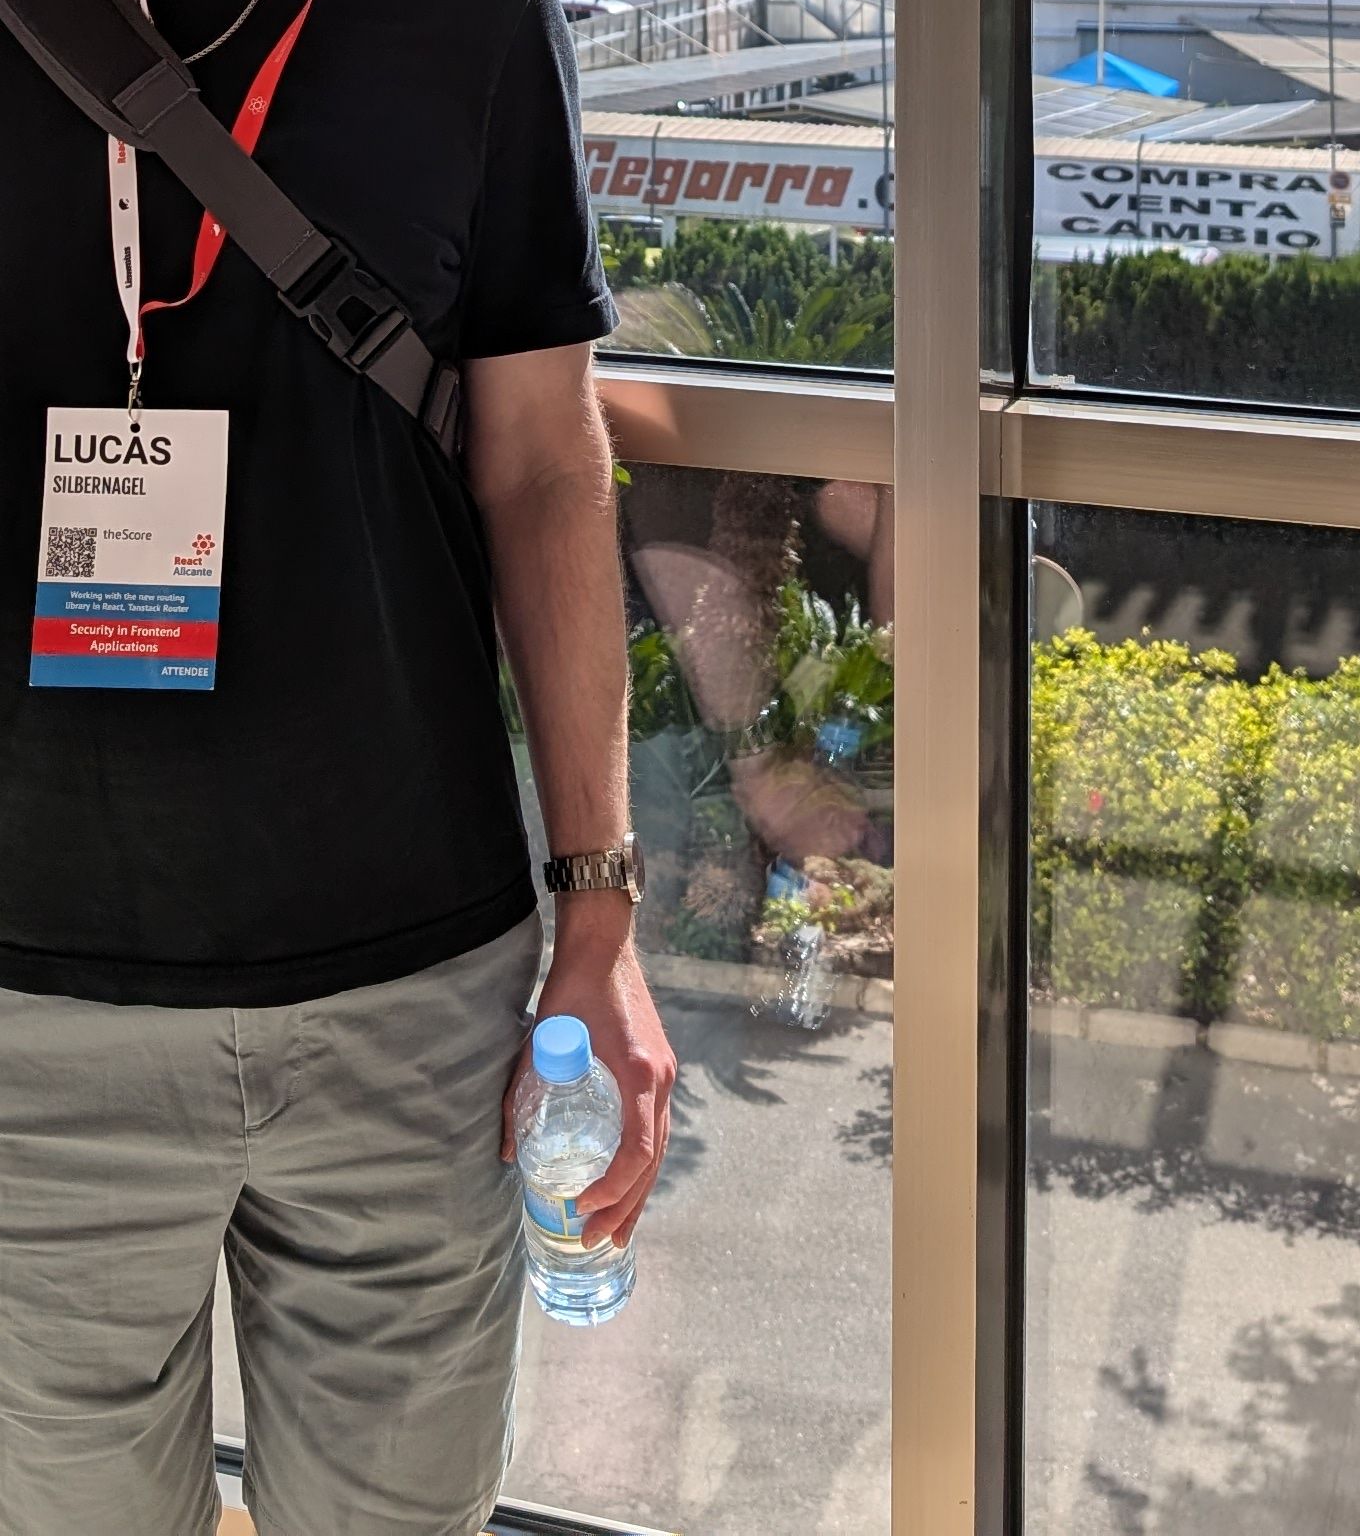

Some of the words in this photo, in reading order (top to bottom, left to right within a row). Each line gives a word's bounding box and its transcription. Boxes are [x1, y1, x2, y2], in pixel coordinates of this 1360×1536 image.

[1046, 163, 1326, 193] COMPRA
[1080, 191, 1300, 220] VENTA
[1061, 216, 1321, 249] CAMBIO
[54, 434, 172, 466] LUCAS
[53, 475, 146, 496] SILBERNAGEL
[103, 528, 152, 541] theScore
[174, 556, 203, 566] React
[173, 567, 213, 577] Alicante
[70, 591, 103, 601] Working
[105, 592, 122, 600] with
[124, 592, 137, 601] the
[157, 593, 186, 603] routing
[93, 602, 101, 610] in
[163, 604, 190, 613] Router
[70, 623, 115, 638] Security
[117, 625, 128, 635] in
[131, 625, 181, 638] Frontend
[90, 640, 159, 653] Applications
[161, 666, 209, 677] ATTENDEE
